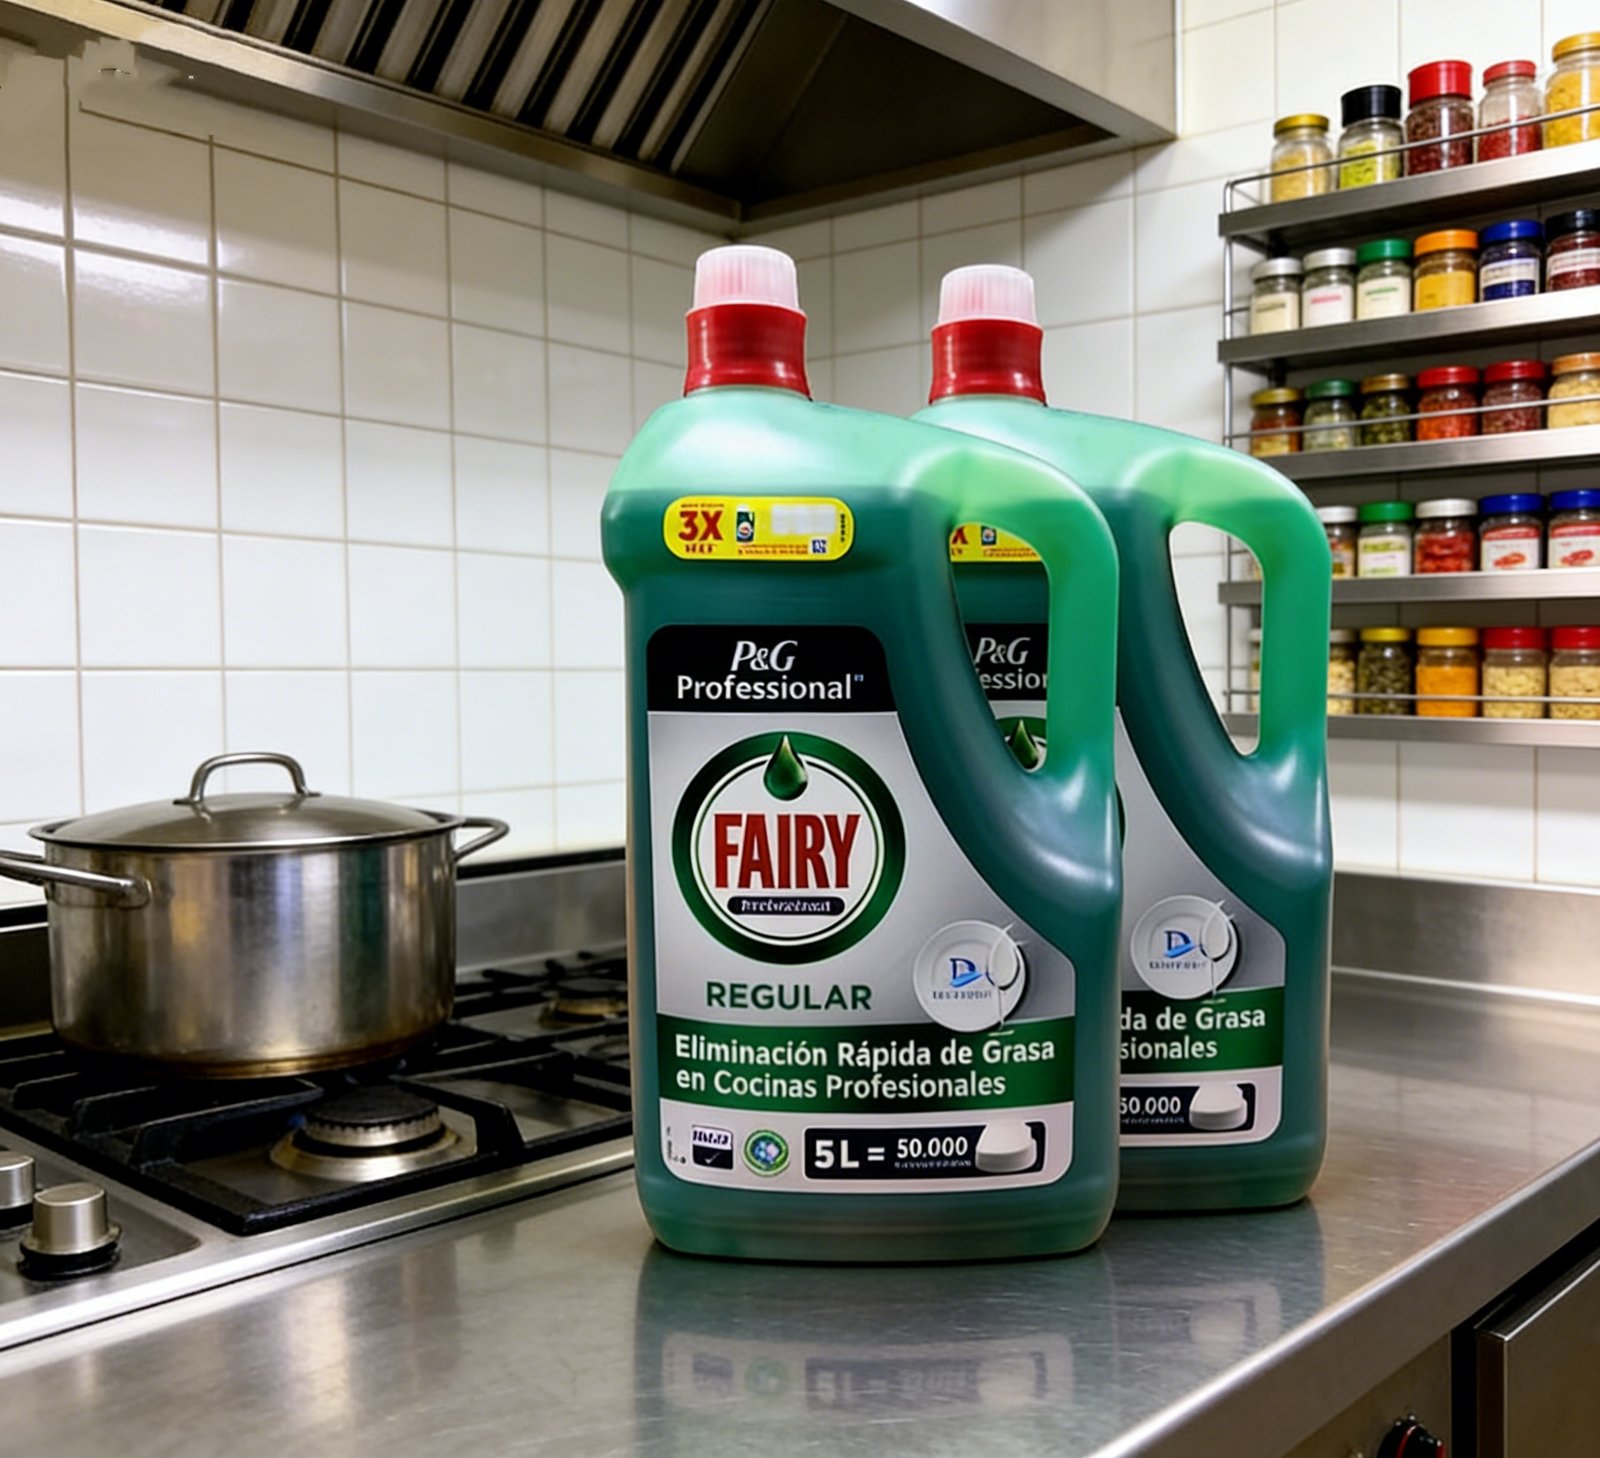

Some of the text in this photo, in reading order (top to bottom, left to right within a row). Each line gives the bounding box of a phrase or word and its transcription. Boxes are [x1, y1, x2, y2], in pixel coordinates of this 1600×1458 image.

[678, 510, 723, 541] 3X
[730, 640, 798, 672] P&G
[975, 637, 1031, 665] P&G
[677, 673, 851, 700] Professional
[975, 667, 1047, 690] essio
[714, 813, 861, 889] FAIRY
[706, 981, 873, 1011] REGULAR
[1156, 1006, 1187, 1030] de
[1196, 1008, 1266, 1030] Grasa
[675, 1034, 1055, 1072] Eliminación Rápida de Grasa
[676, 1069, 1006, 1098] en Cocinas Profesionales
